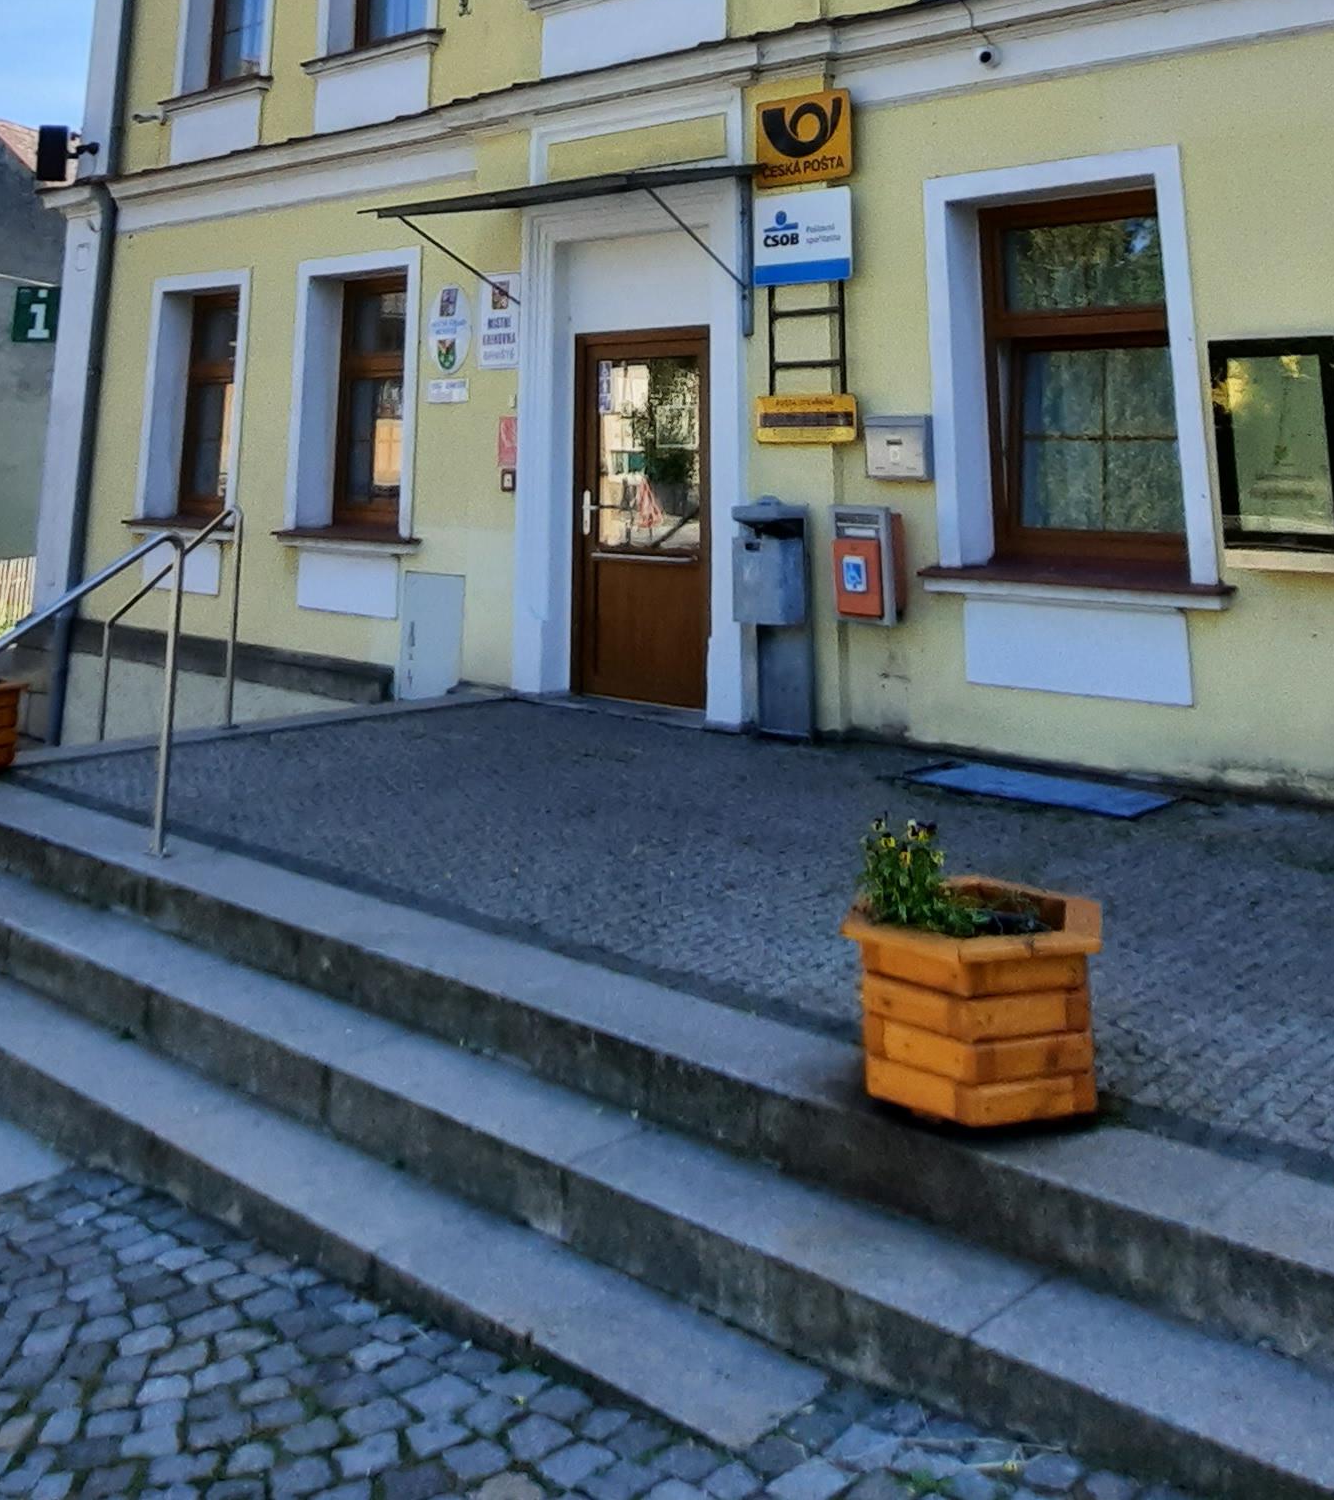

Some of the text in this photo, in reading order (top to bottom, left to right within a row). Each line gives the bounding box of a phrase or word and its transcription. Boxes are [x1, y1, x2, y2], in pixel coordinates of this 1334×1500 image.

[762, 155, 844, 179] ČESKÁ POŠTA
[763, 232, 799, 248] ČSOB
